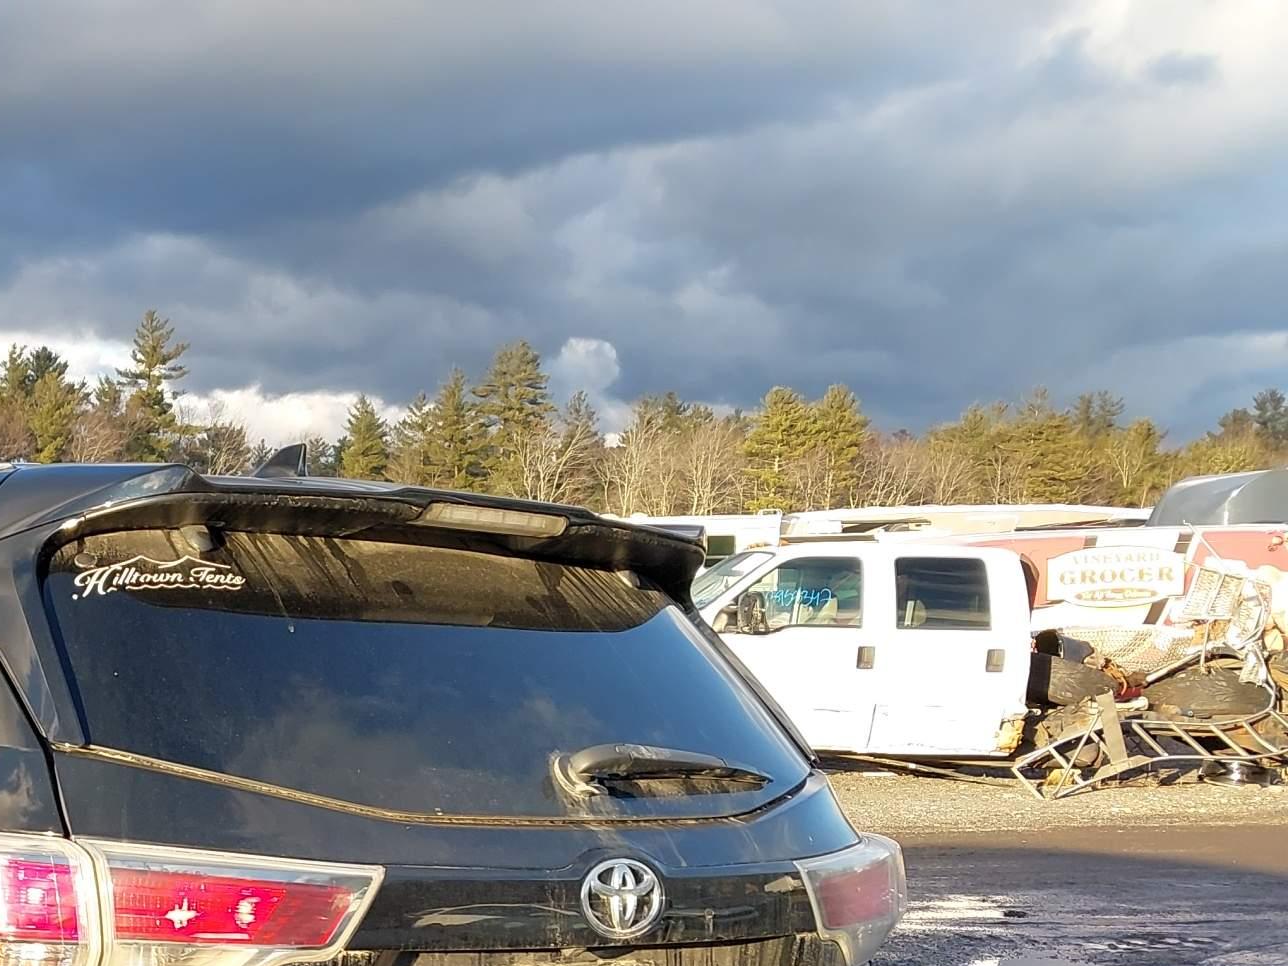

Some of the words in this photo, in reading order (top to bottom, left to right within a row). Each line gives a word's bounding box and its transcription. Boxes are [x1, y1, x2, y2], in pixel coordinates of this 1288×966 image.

[73, 566, 182, 599] Hilltown
[189, 566, 246, 585] Tents
[1059, 567, 1175, 585] GROCER
